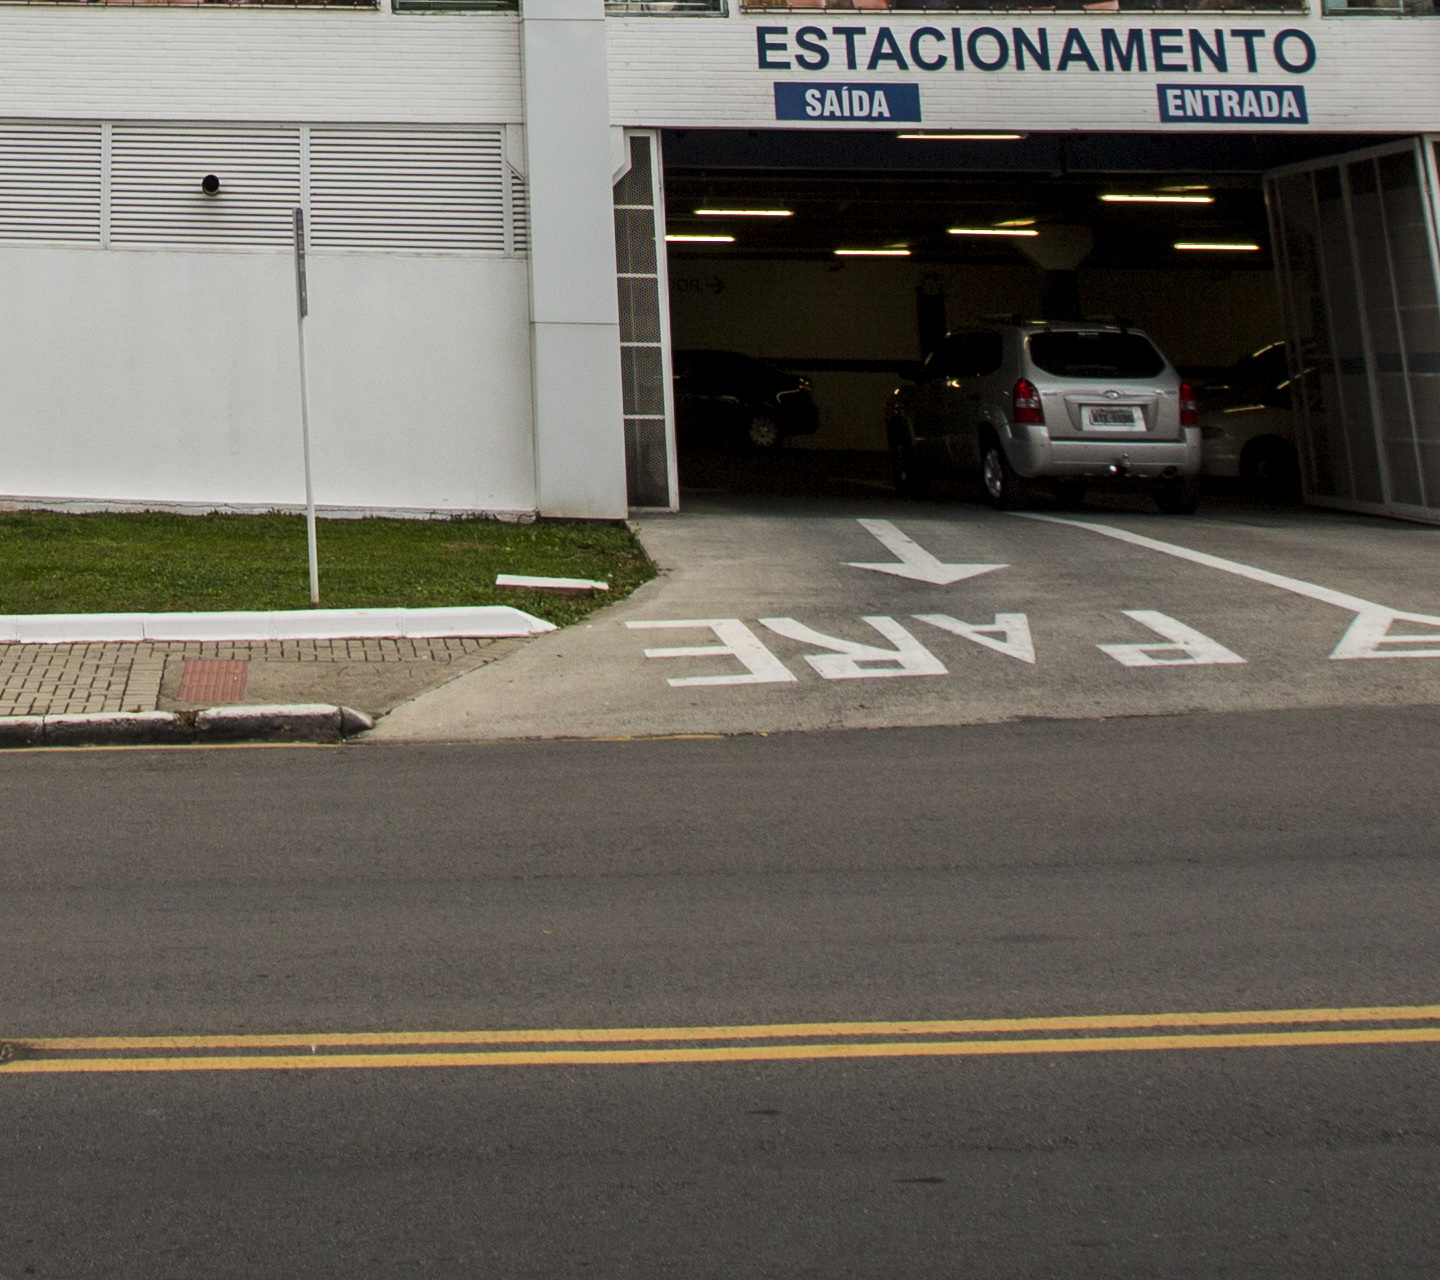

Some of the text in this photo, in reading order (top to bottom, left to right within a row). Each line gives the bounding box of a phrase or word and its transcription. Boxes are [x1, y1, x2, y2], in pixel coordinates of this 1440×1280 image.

[756, 24, 1318, 74] ESTACIONAMENTO
[805, 86, 891, 118] SAÍDA
[1165, 88, 1301, 119] ENTRADA
[626, 609, 1248, 688] PARE
